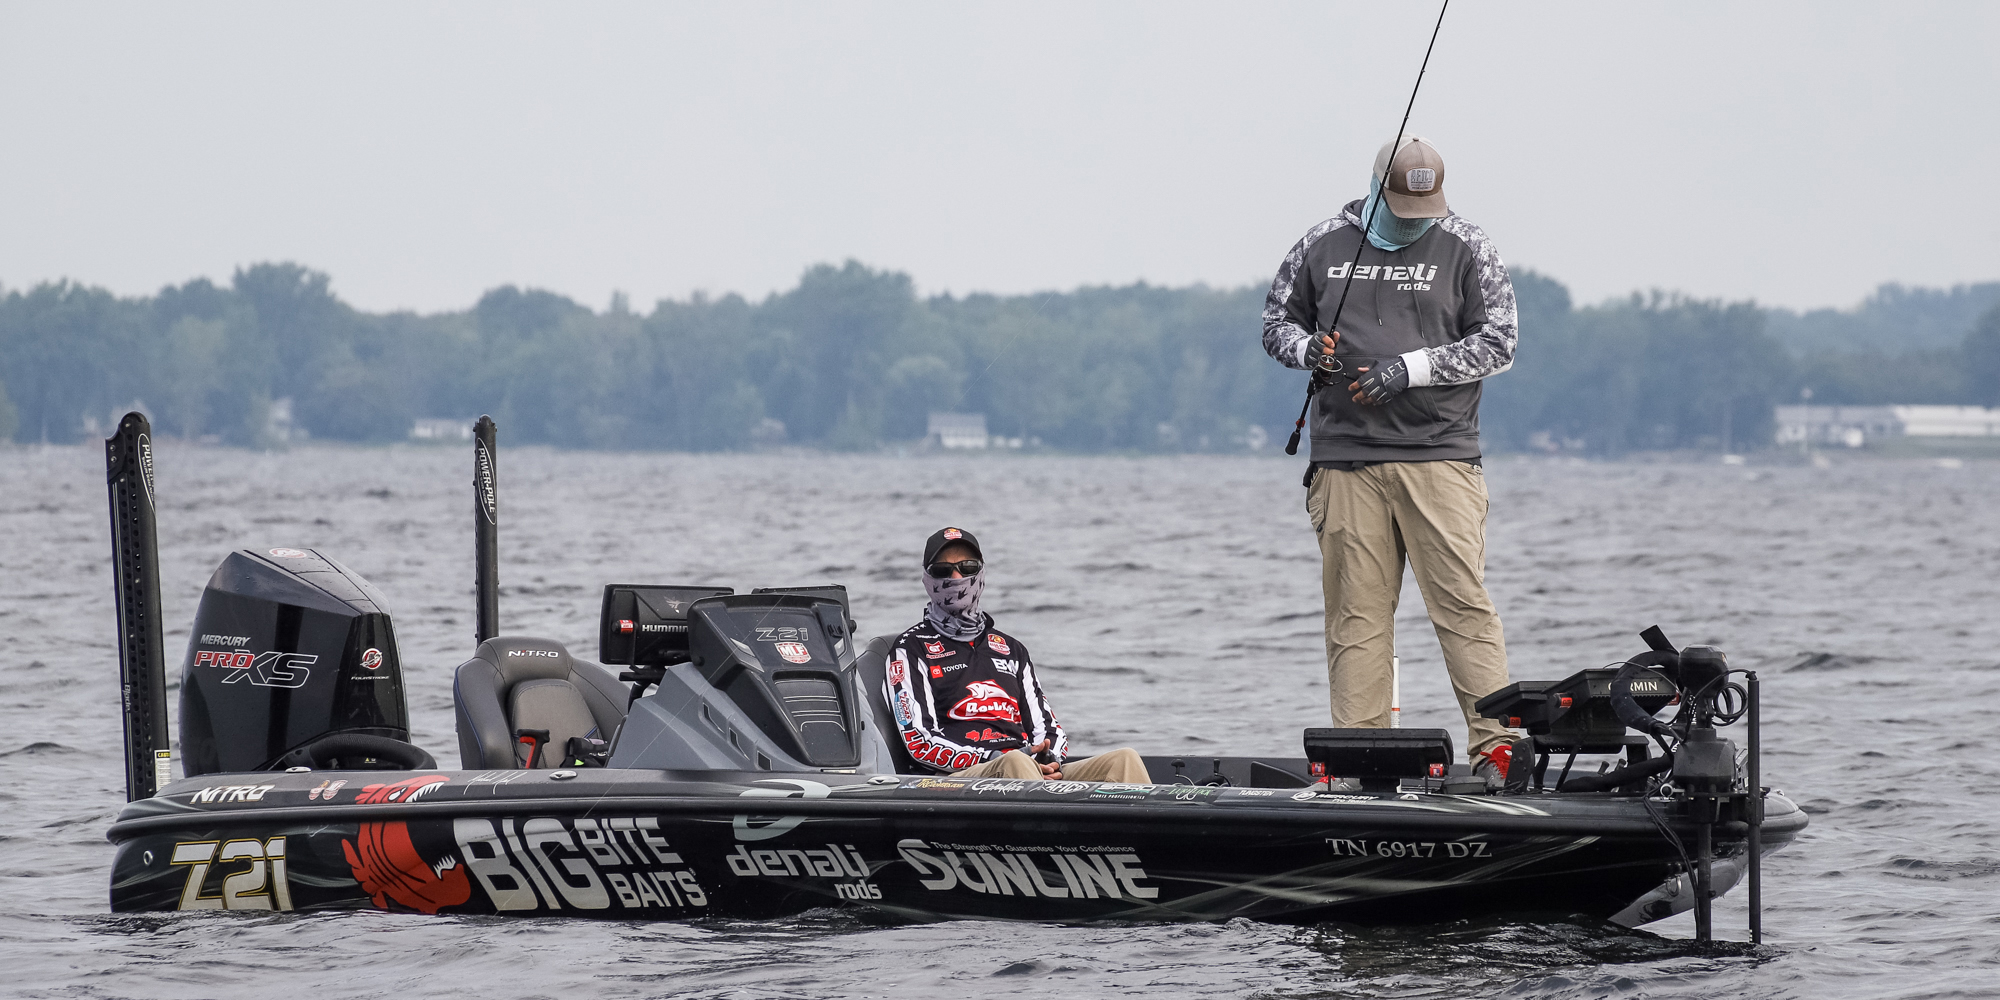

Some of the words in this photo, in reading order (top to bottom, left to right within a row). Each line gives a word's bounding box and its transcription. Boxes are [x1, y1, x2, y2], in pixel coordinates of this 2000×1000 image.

[1327, 261, 1438, 281] denali
[1397, 282, 1432, 291] rods
[478, 447, 496, 513] POWER-POLE
[201, 634, 251, 647] MERCURY
[755, 626, 809, 642] Z21
[194, 650, 256, 668] PRO
[221, 649, 319, 688] XS
[942, 663, 968, 673] TOYOTA
[903, 729, 954, 767] LUCAS
[930, 841, 950, 849] The
[951, 843, 991, 852] Strength
[1005, 844, 1054, 852] Guarantee
[1325, 838, 1368, 857] TN
[1376, 841, 1436, 858] 6917
[1443, 842, 1493, 858] DZ
[453, 818, 611, 911] BIG
[574, 817, 684, 866] BITE
[726, 843, 870, 878] denali
[897, 838, 1160, 899] SUNLINE
[170, 836, 295, 912] Z21
[605, 870, 708, 908] BAITS
[834, 880, 883, 900] rods
